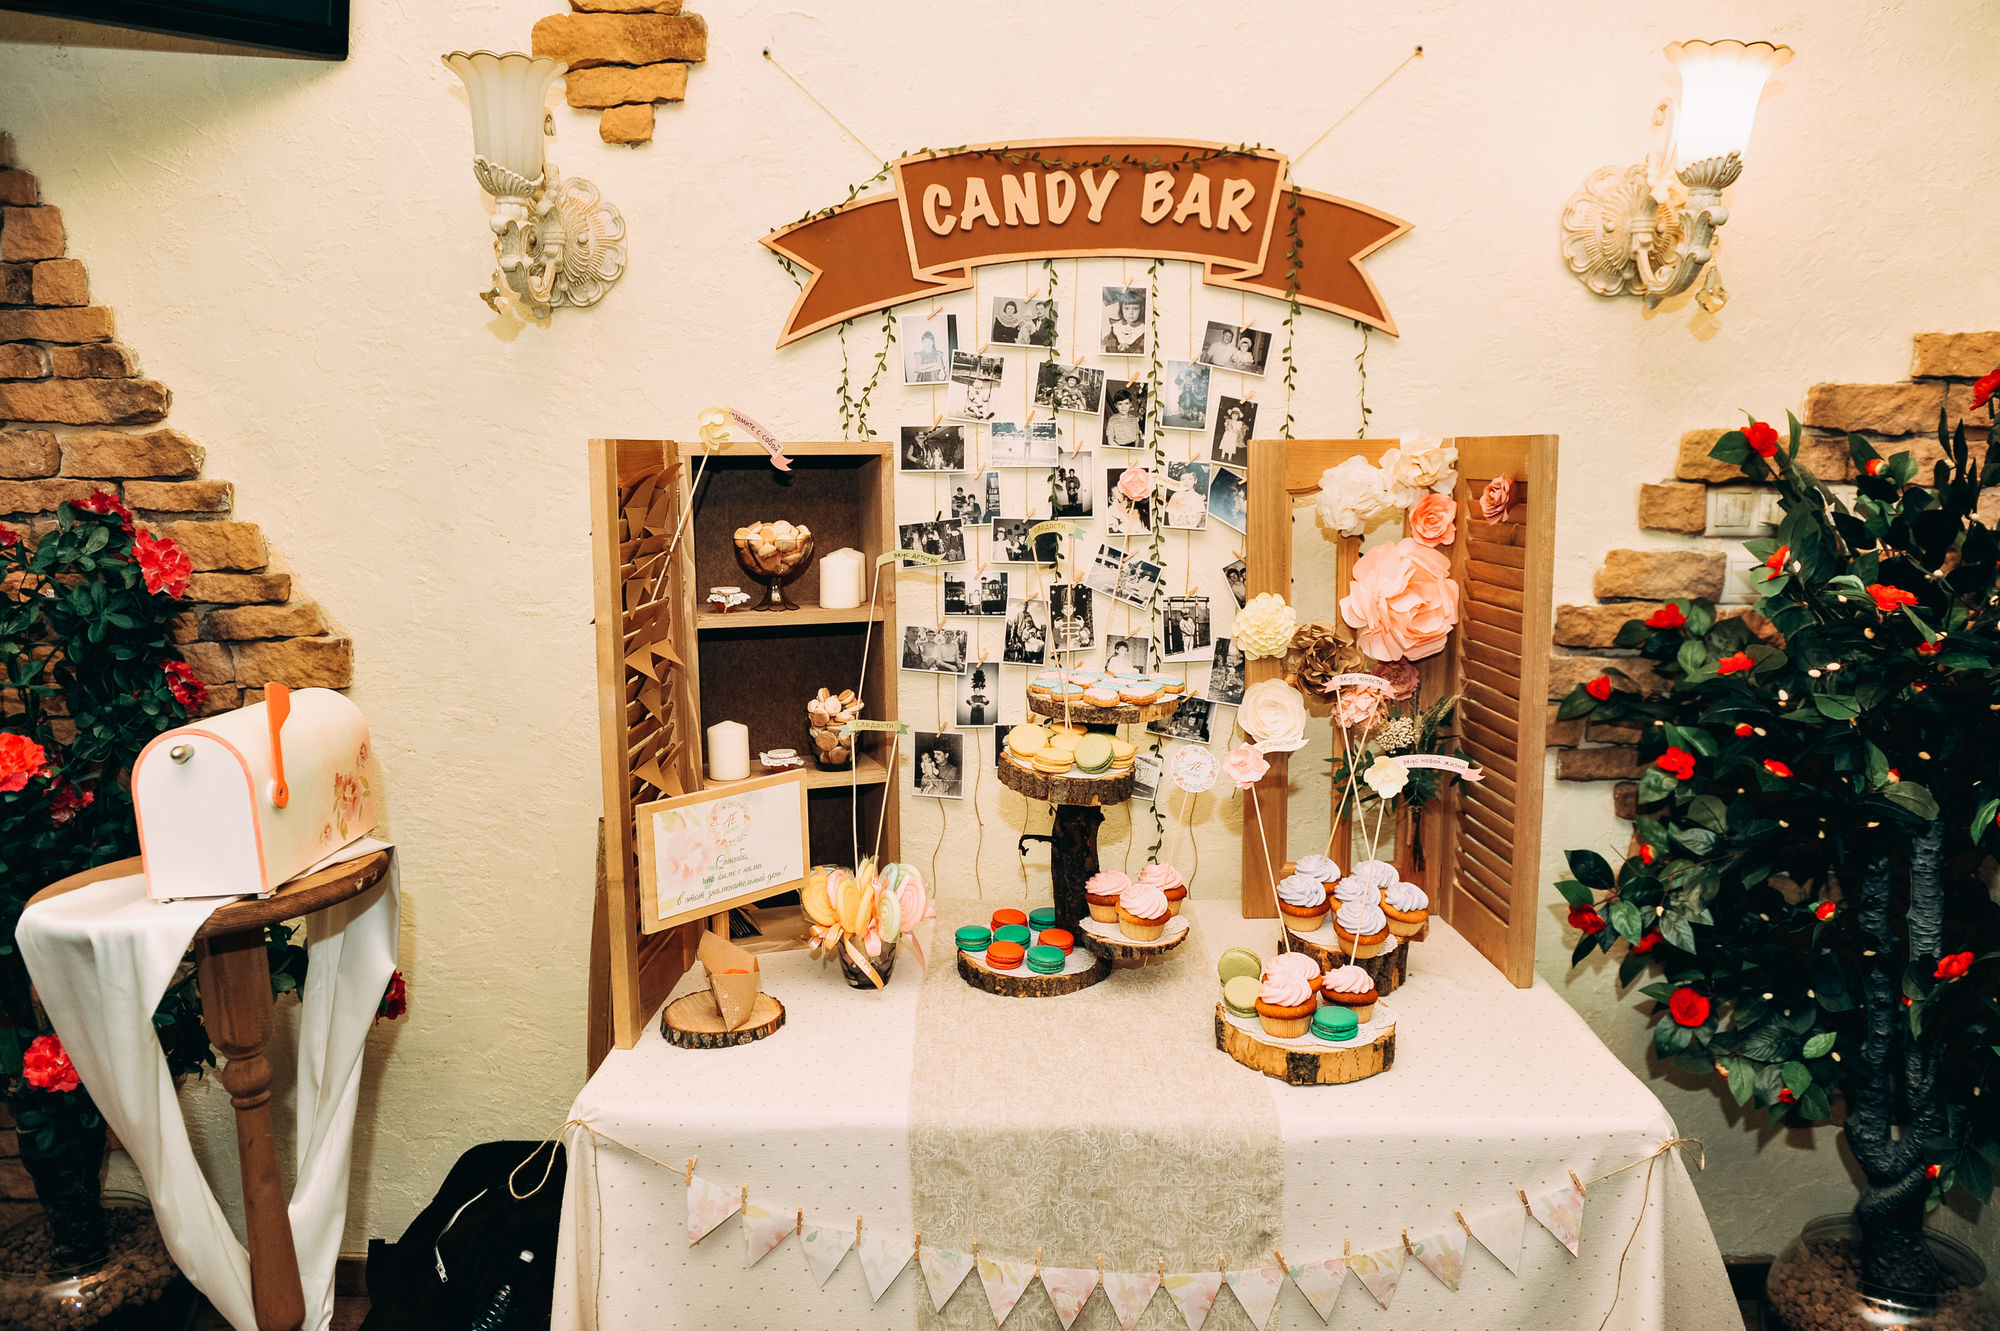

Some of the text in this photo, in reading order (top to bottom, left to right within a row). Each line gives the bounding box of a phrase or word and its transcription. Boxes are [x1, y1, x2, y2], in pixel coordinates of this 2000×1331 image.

[922, 169, 1256, 236] CANDY BAR
[761, 434, 781, 453] собой
